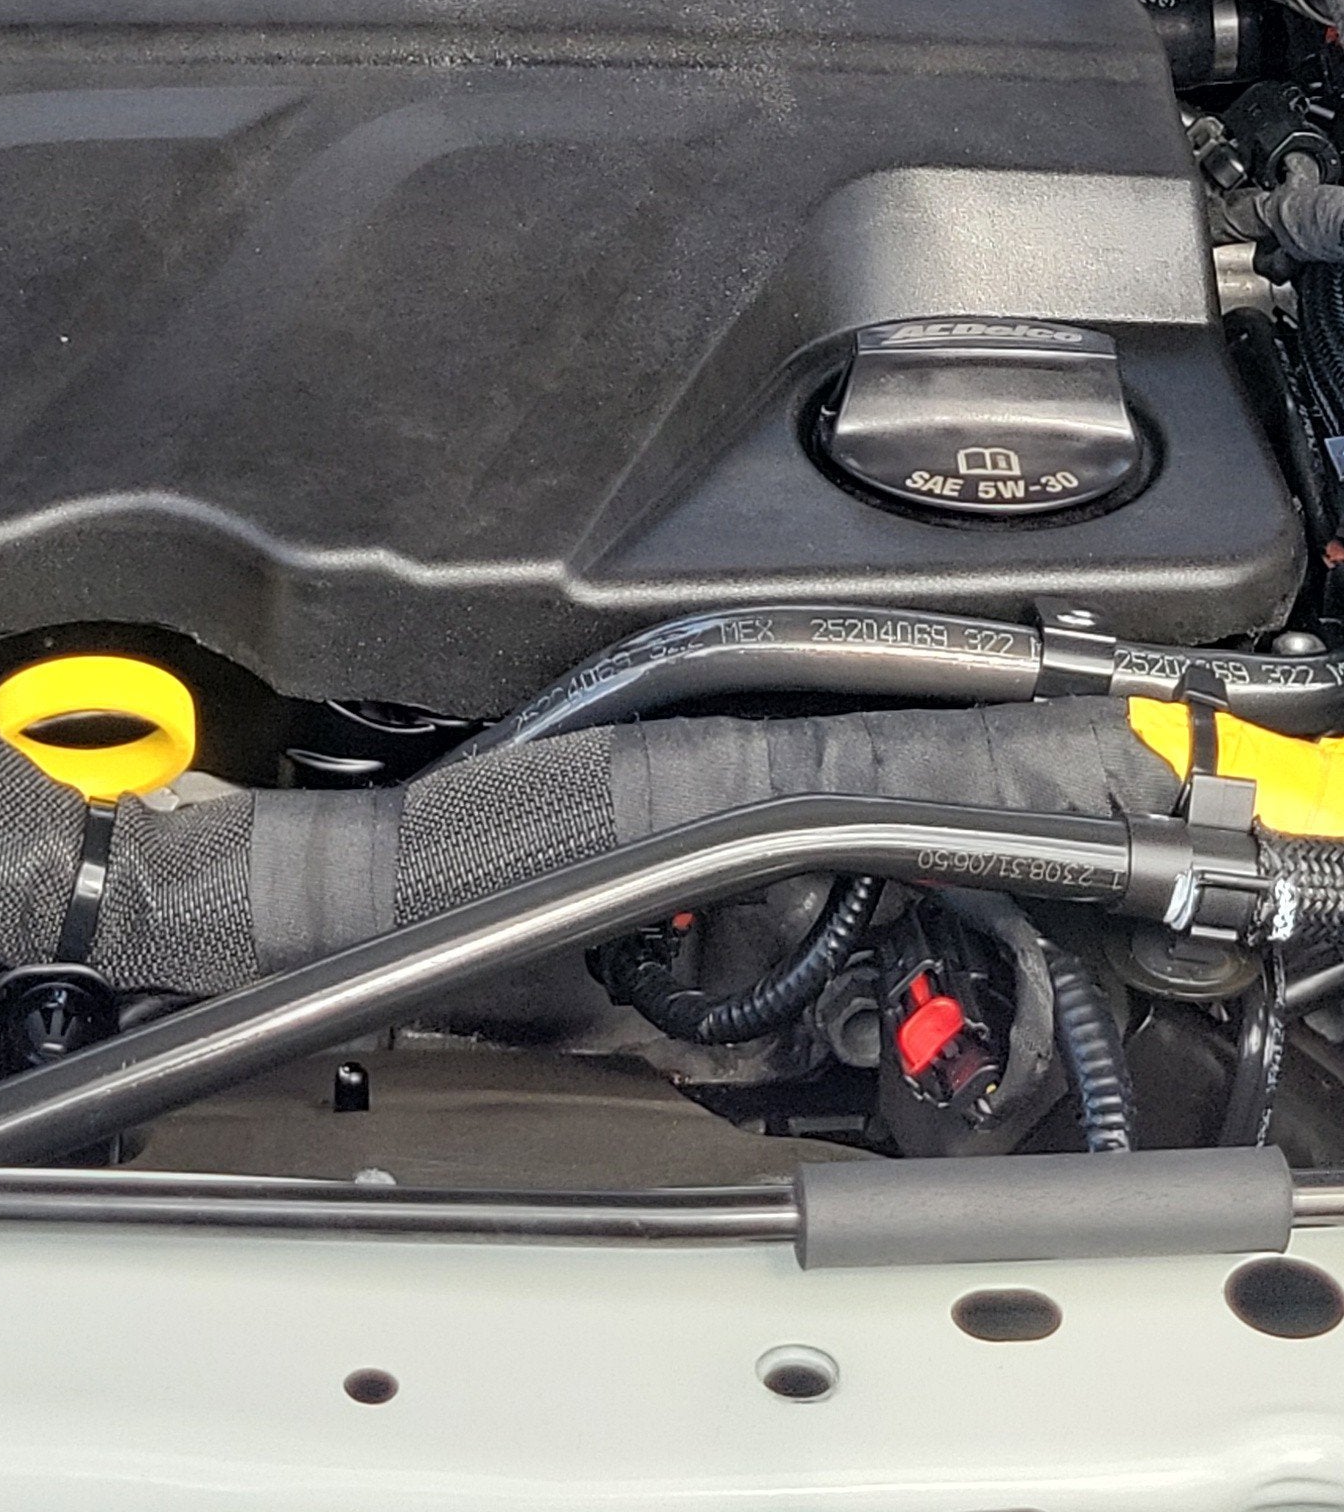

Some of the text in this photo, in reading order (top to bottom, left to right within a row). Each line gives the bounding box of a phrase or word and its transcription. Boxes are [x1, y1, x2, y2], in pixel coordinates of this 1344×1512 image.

[905, 470, 1079, 500] SAE 5W-30
[718, 619, 775, 644] MEX
[810, 619, 948, 649] 25204069
[964, 628, 1014, 655] 322
[1114, 649, 1250, 684] 252069
